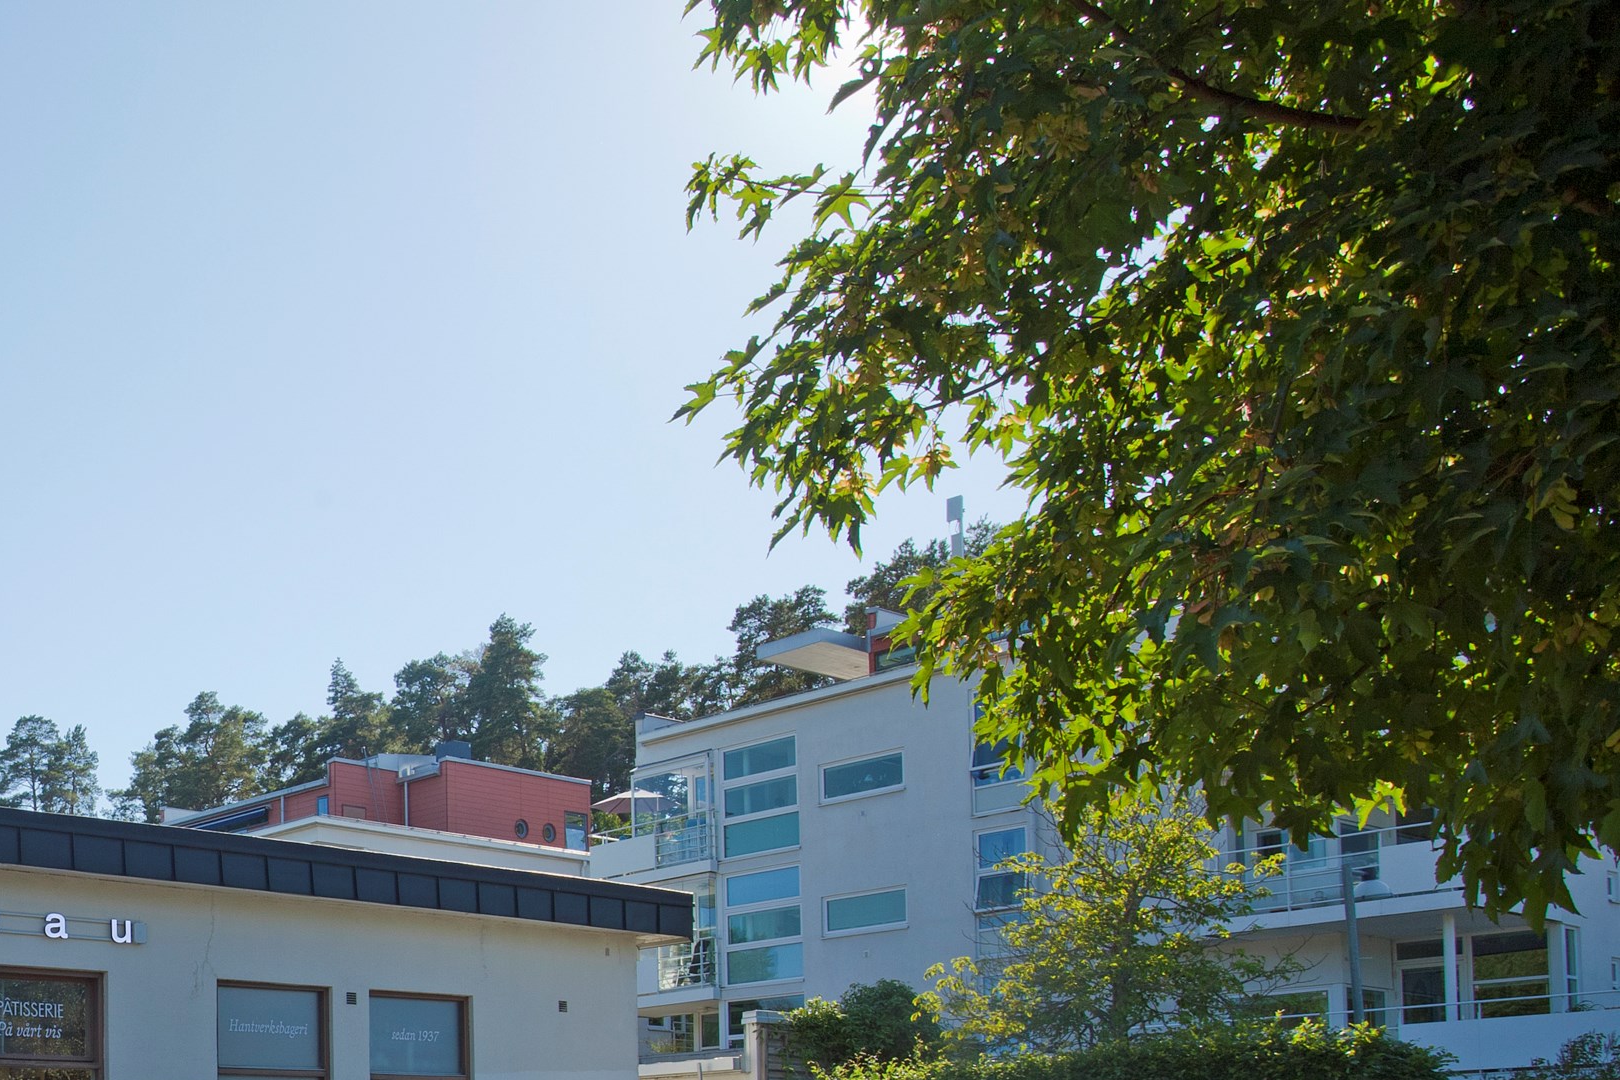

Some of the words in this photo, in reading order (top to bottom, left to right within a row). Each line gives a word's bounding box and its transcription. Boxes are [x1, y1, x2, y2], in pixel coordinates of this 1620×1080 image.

[16, 1022, 42, 1038] vårt
[45, 1024, 62, 1039] vis
[229, 1018, 308, 1040] Hantverksbageri
[392, 1027, 416, 1041] sedan
[418, 1030, 440, 1042] 1937
